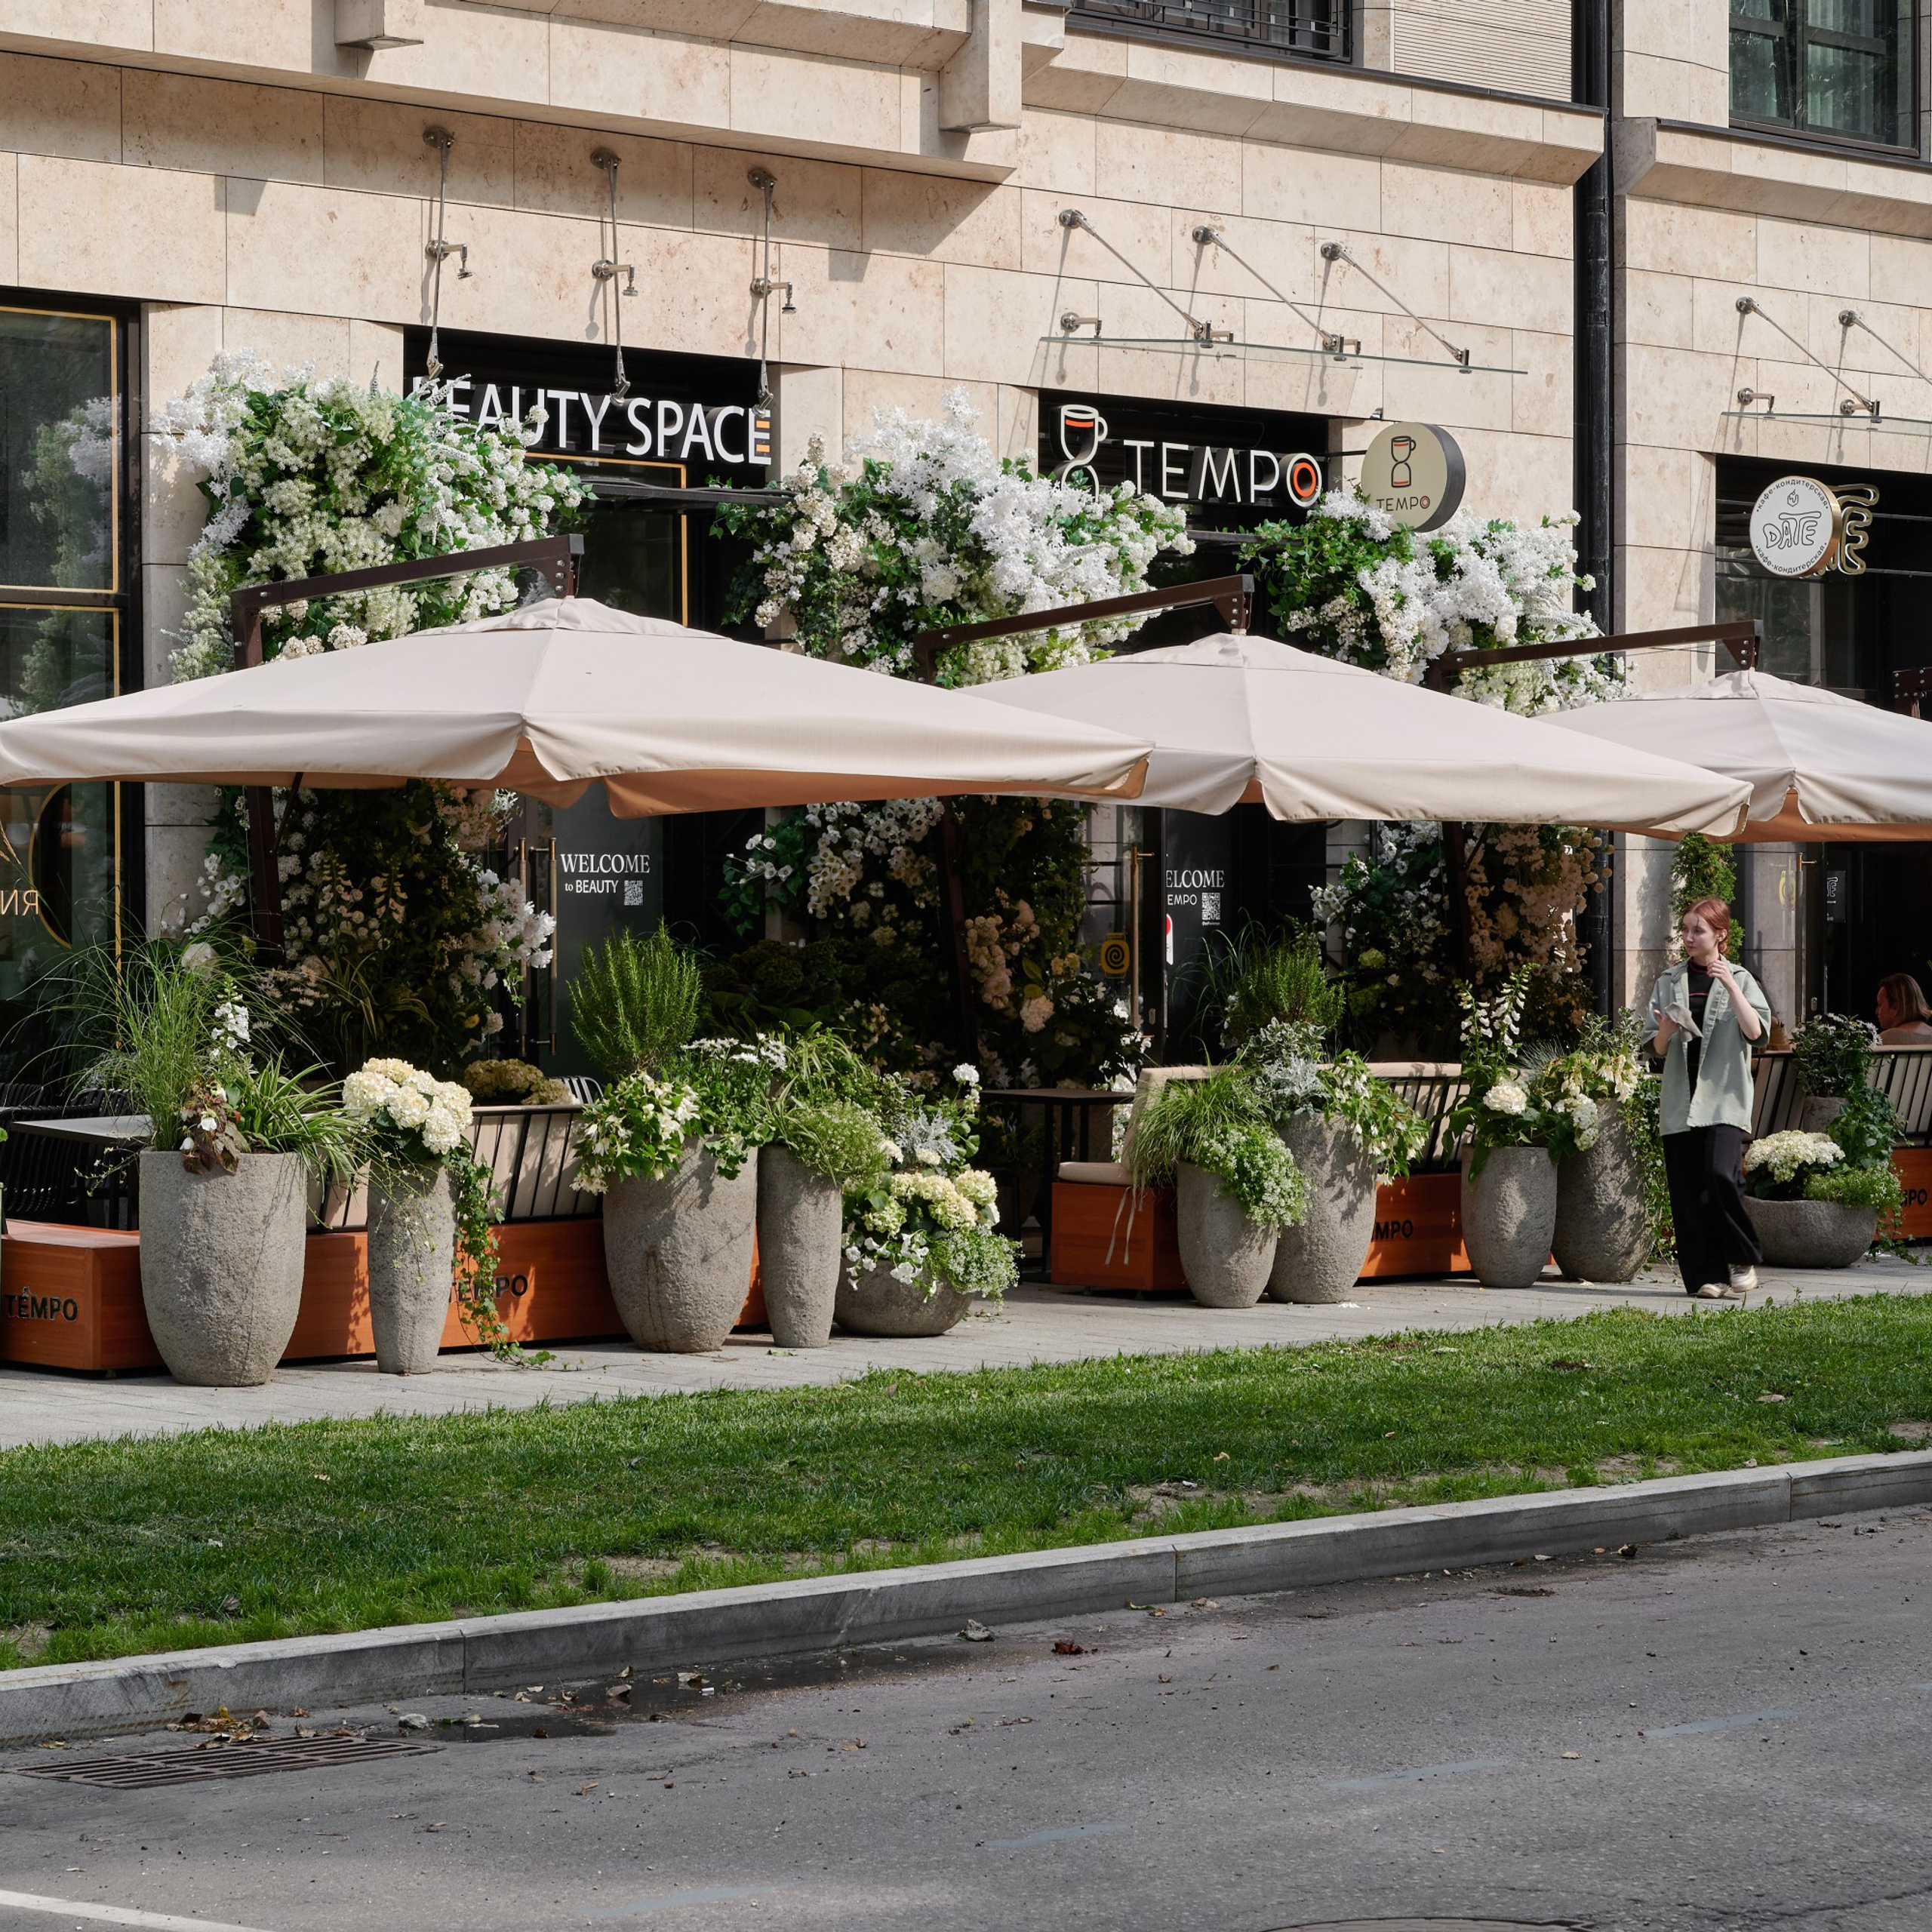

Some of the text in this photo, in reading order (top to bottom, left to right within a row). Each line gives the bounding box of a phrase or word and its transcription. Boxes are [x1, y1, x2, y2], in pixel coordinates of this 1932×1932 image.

[626, 397, 771, 465] SPACE
[1124, 439, 1322, 507] TEMPO
[1376, 495, 1430, 511] TEMPO
[1762, 511, 1822, 550] DATE
[561, 854, 651, 873] WELCOME
[565, 879, 618, 894] to BEAUTY
[1166, 870, 1225, 888] ELCOME
[1168, 894, 1198, 906] EMPO
